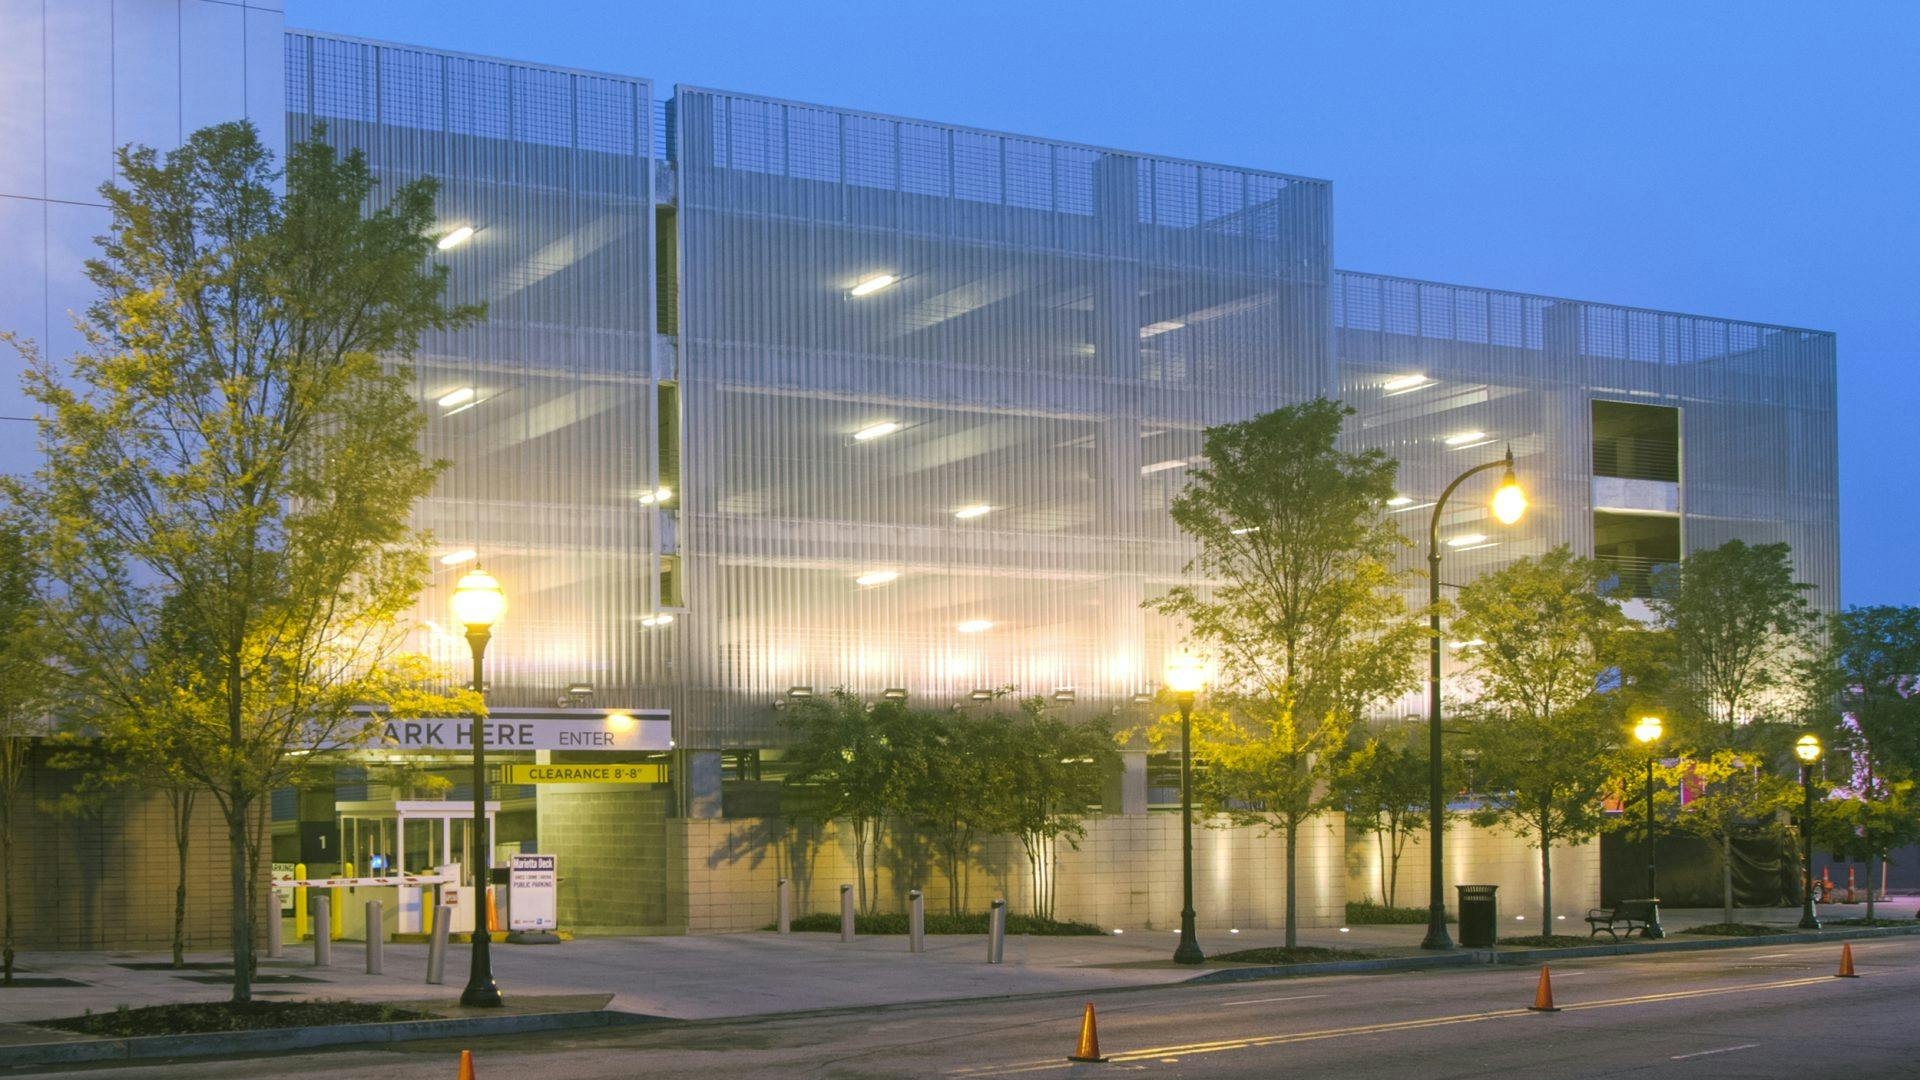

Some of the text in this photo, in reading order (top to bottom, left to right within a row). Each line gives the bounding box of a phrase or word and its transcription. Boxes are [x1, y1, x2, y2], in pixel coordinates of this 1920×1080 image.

[366, 722, 534, 745] ARK HERE
[559, 731, 615, 746] ENTER
[529, 768, 609, 780] CLEARANCE
[318, 835, 326, 849] 1
